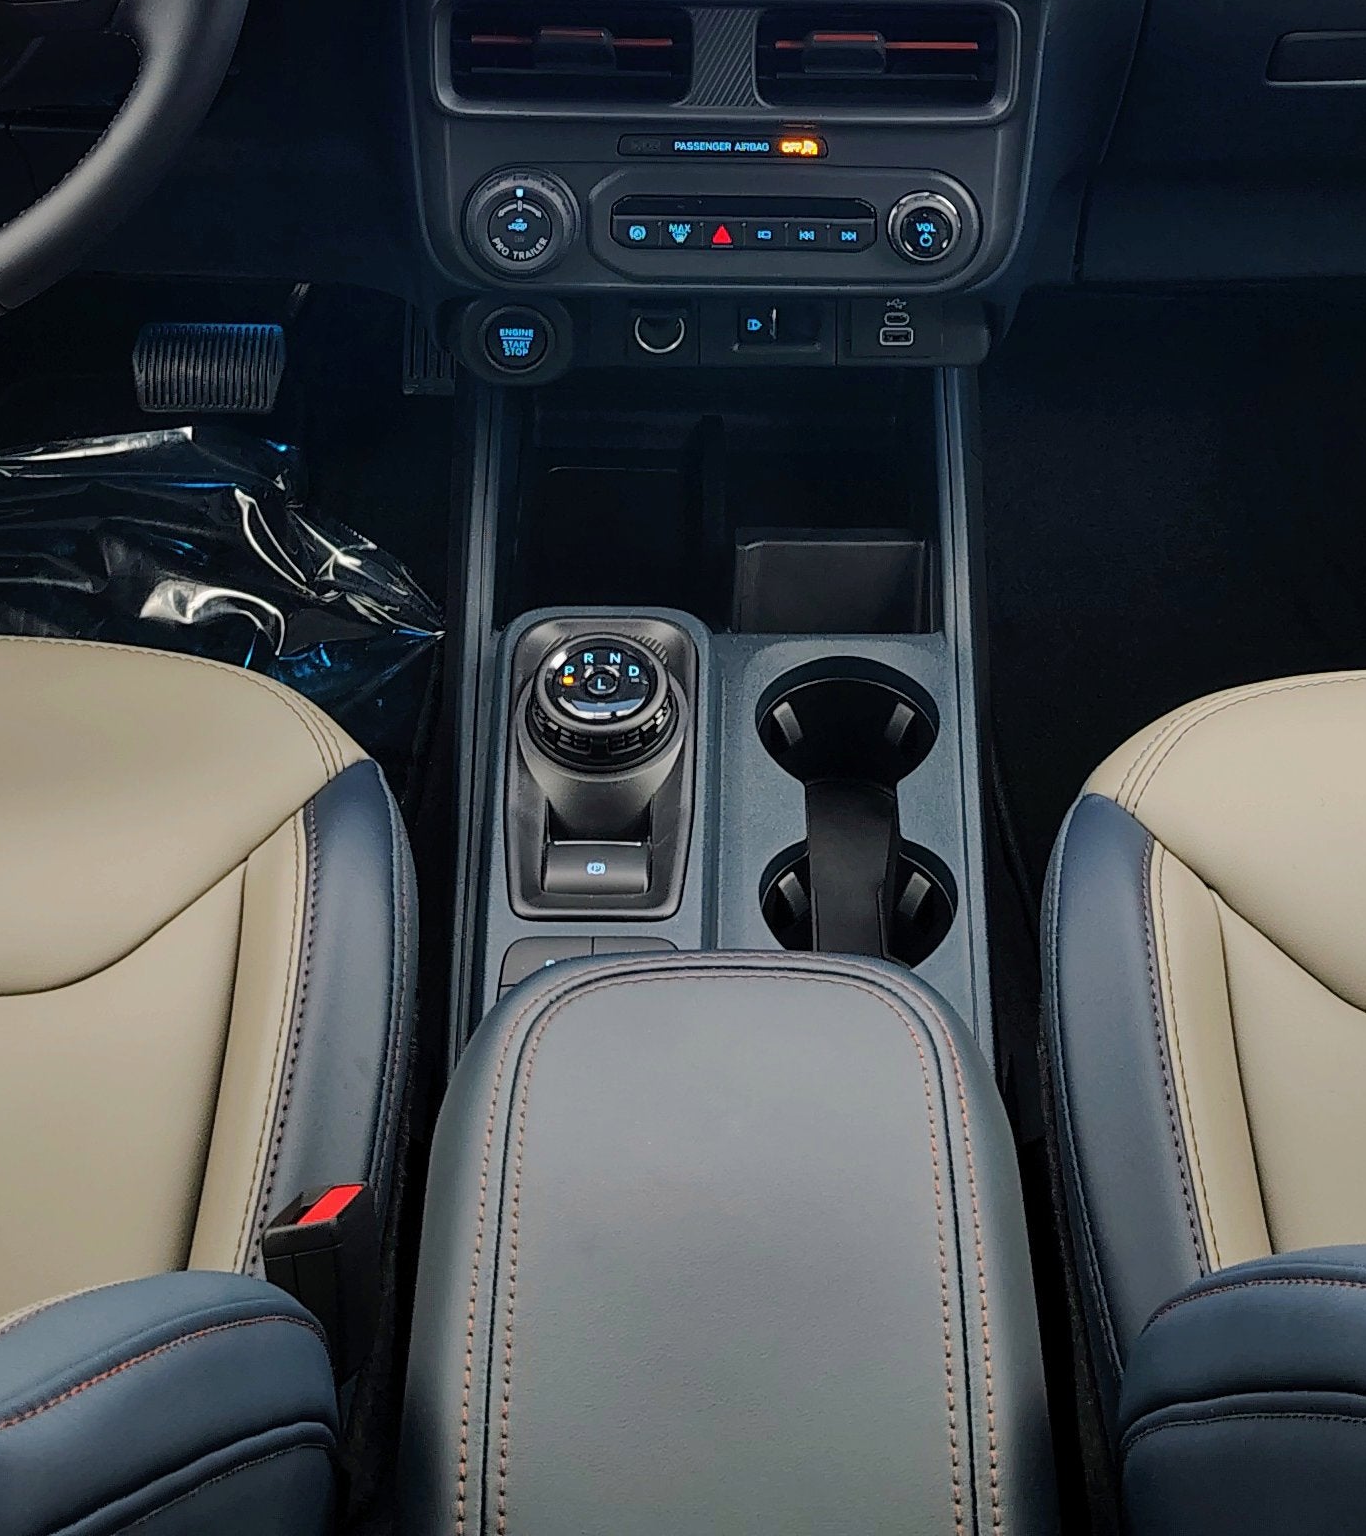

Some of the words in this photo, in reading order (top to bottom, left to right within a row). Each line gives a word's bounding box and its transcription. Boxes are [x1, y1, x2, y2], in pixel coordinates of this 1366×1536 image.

[673, 141, 731, 152] PASSENGER
[734, 141, 770, 152] AIRBAG
[668, 223, 692, 233] MAX
[915, 222, 937, 233] VOL
[491, 237, 510, 257] PRO
[512, 237, 549, 261] TRAILER
[499, 328, 534, 338] ENGINE
[502, 340, 531, 349] START
[504, 348, 529, 357] STOP
[564, 665, 575, 676] P
[583, 652, 594, 665] R
[609, 652, 621, 665] N
[628, 665, 640, 677] D
[597, 678, 606, 690] L
